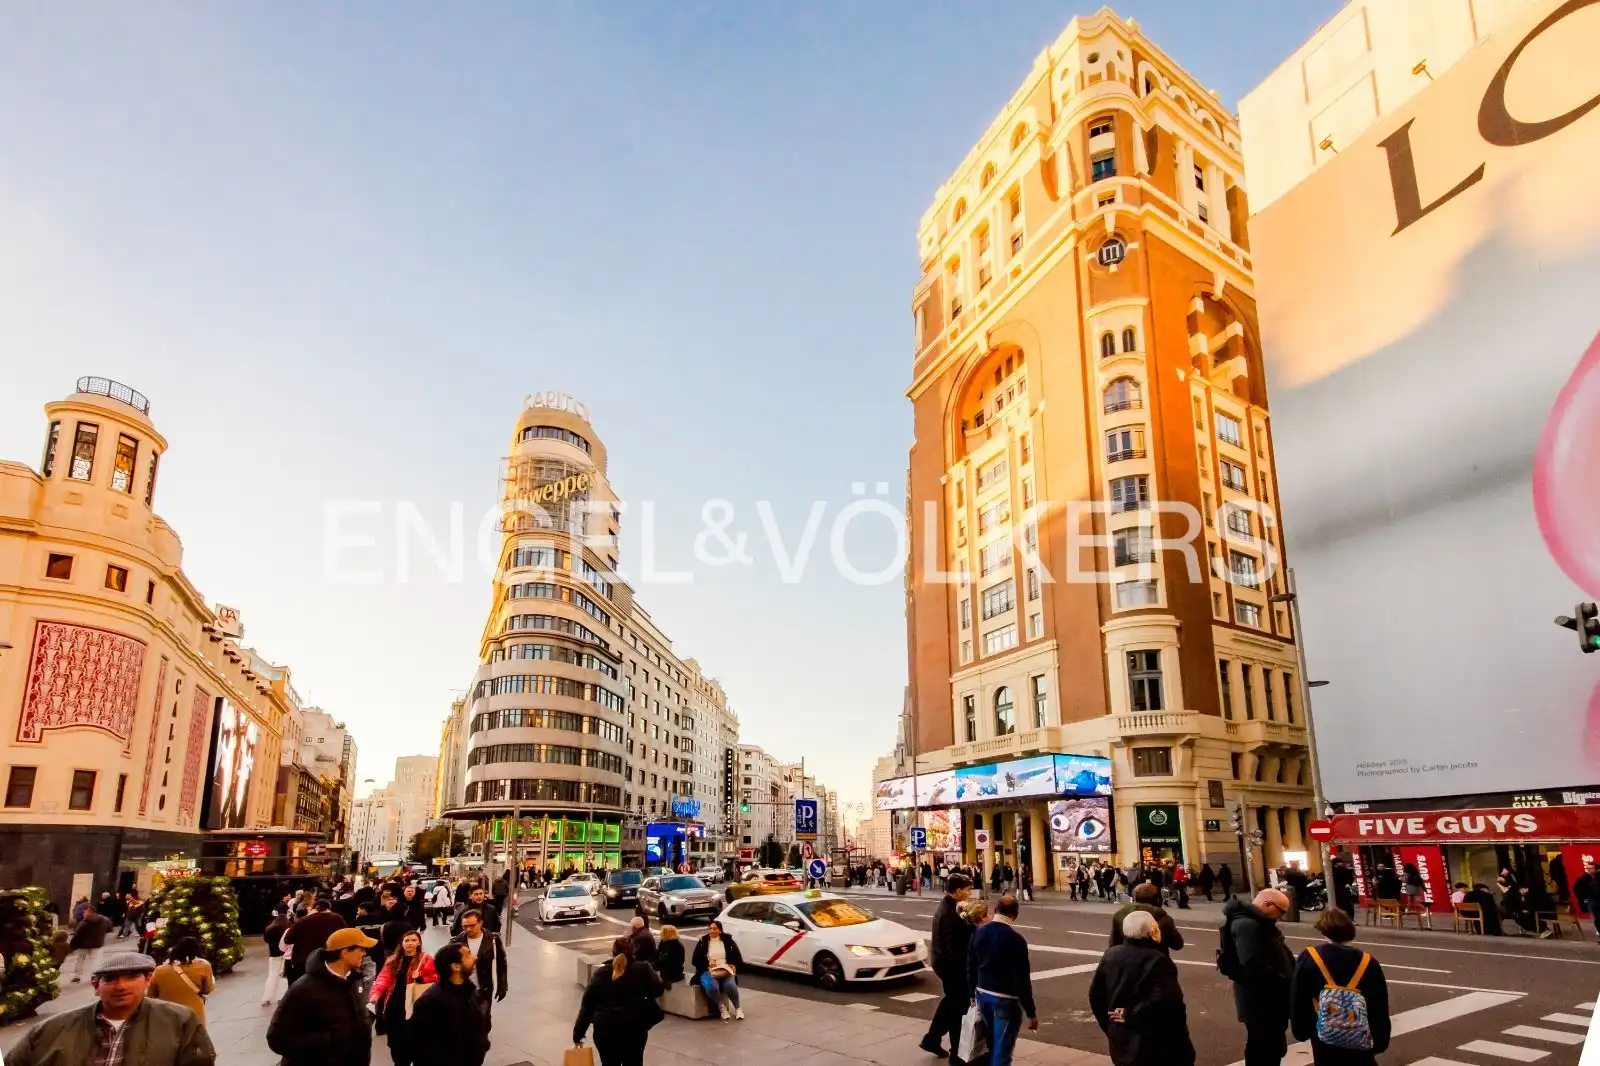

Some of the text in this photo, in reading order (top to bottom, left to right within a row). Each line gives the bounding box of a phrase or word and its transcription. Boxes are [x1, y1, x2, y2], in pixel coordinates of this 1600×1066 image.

[158, 677, 182, 812] CALLAO
[1410, 766, 1420, 774] by
[1450, 761, 1479, 771] Jacobs
[1512, 800, 1549, 808] GUYS
[1358, 813, 1538, 836] FIVE GUYS
[1352, 853, 1366, 896] FIVE GUYS
[1416, 854, 1429, 881] GUYS
